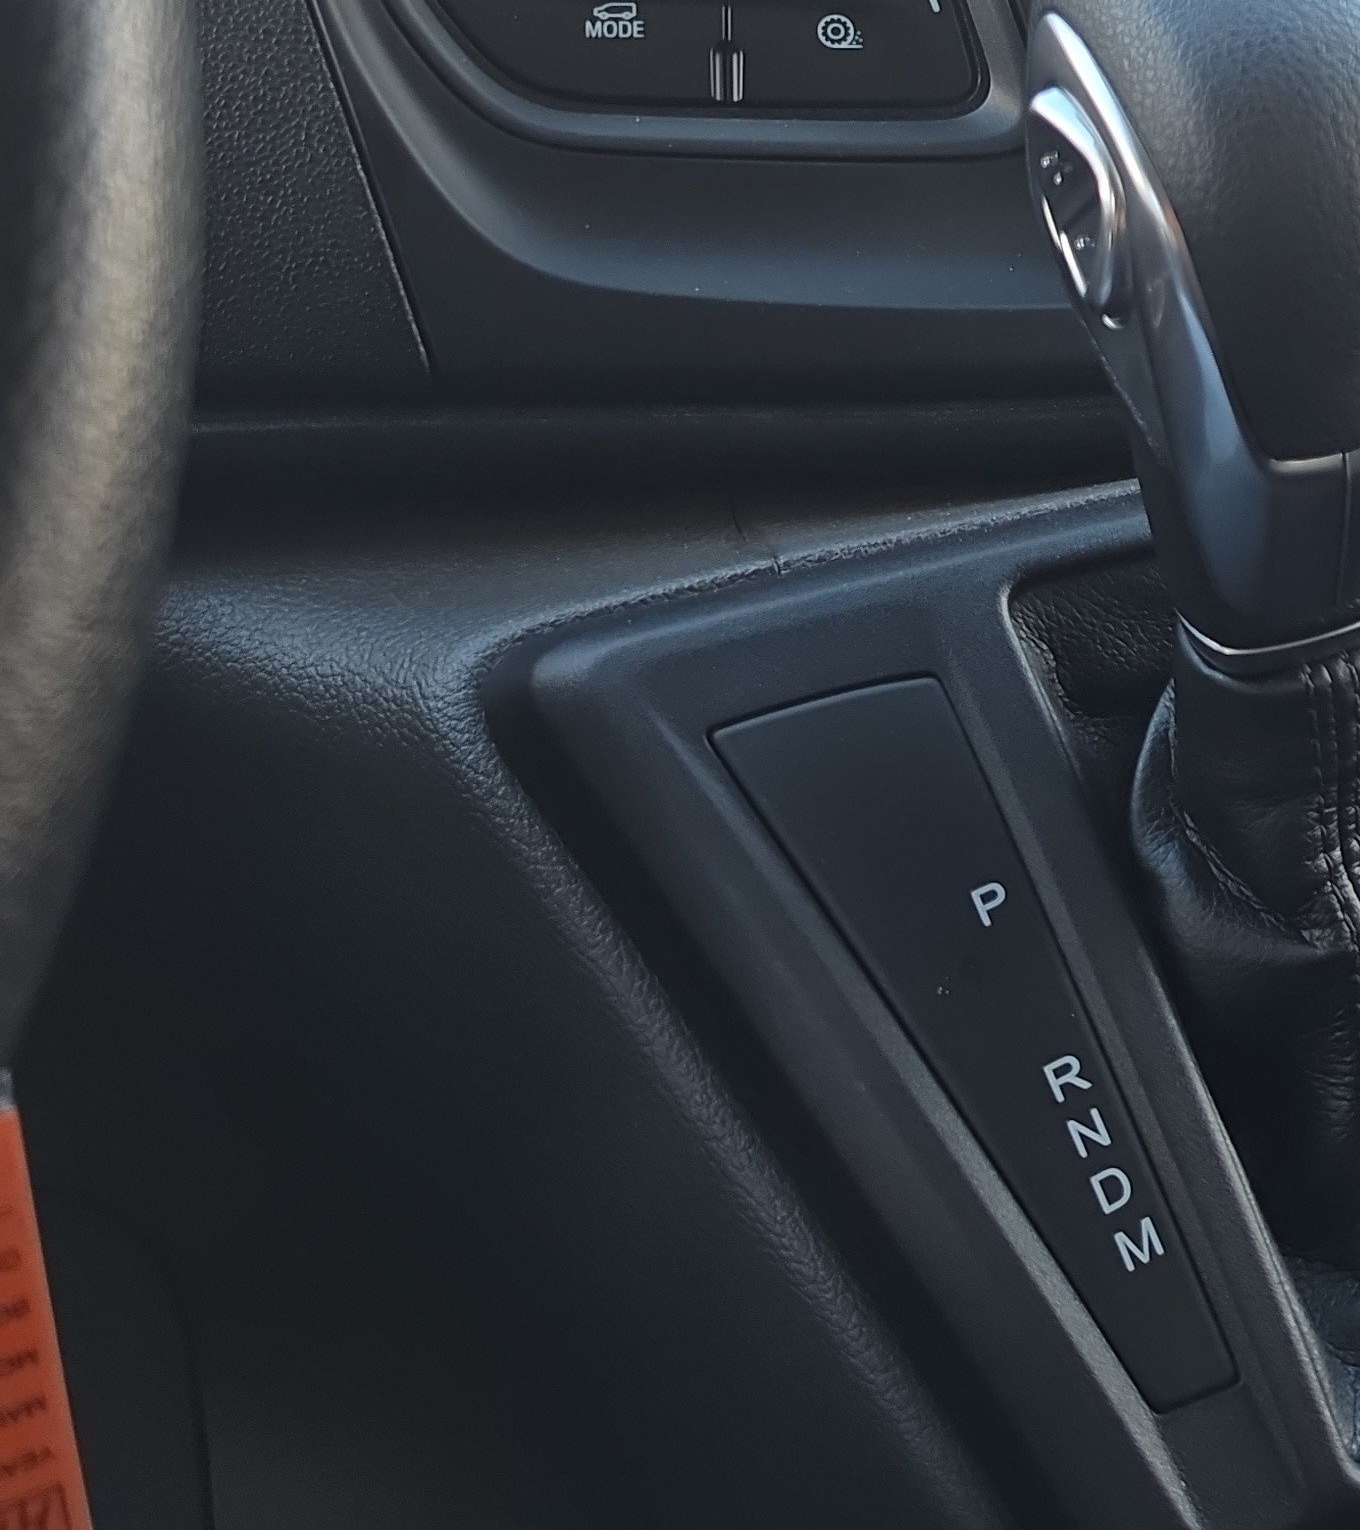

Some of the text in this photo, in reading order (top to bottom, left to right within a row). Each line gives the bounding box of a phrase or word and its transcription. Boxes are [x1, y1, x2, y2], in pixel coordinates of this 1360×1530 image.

[585, 20, 645, 39] MODE
[971, 882, 1006, 927] P
[1043, 1055, 1093, 1103] R
[1067, 1108, 1111, 1158] N
[1090, 1168, 1131, 1214] D
[1114, 1217, 1165, 1271] M
